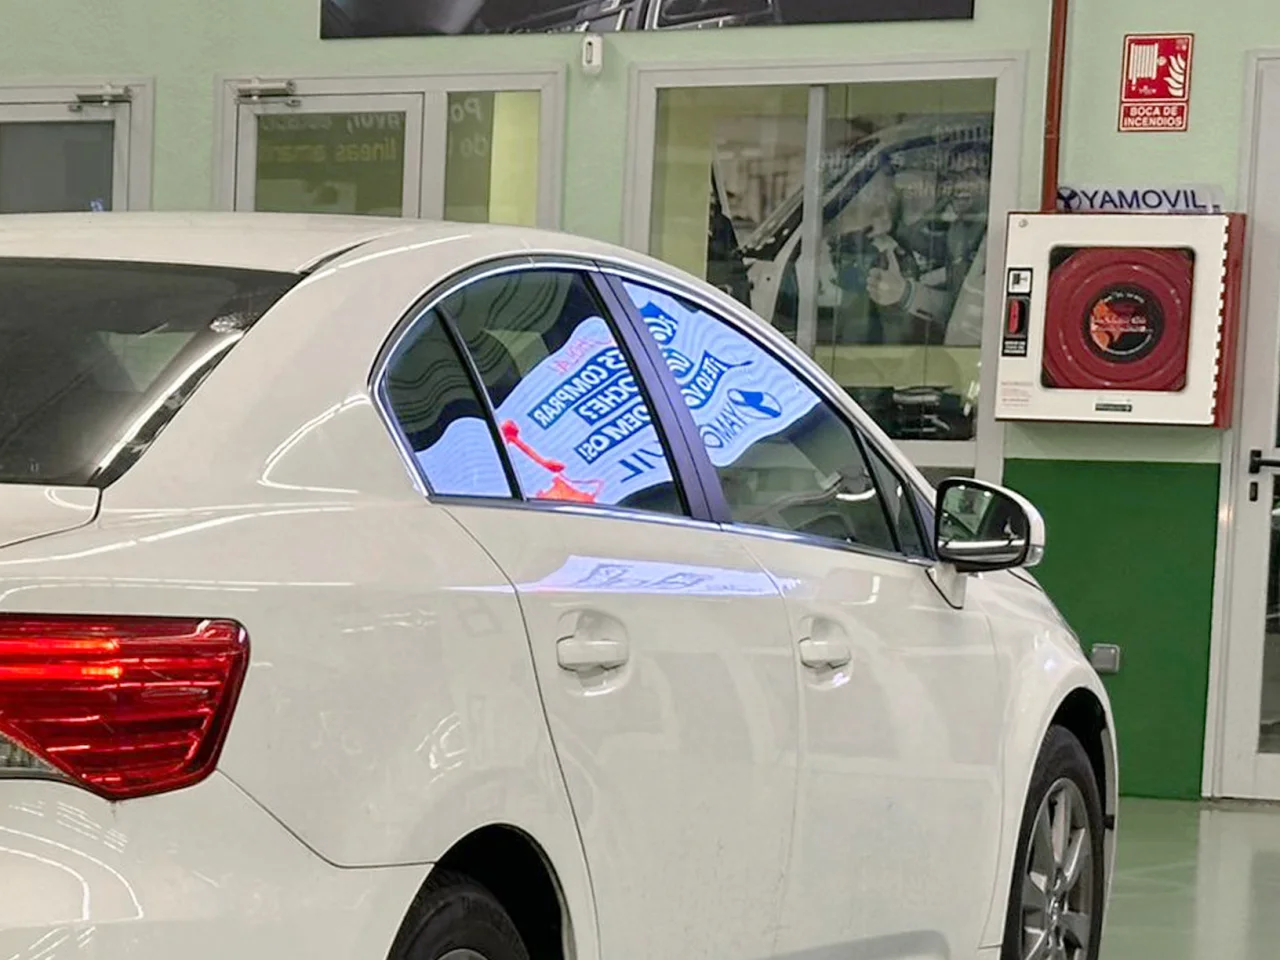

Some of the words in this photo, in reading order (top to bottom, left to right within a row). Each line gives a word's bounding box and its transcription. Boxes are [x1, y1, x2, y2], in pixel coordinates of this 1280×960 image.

[1130, 106, 1160, 116] BOCA
[1163, 106, 1178, 115] DE
[1123, 116, 1182, 127] INCENDIOS
[1080, 189, 1207, 209] YAMOVIL
